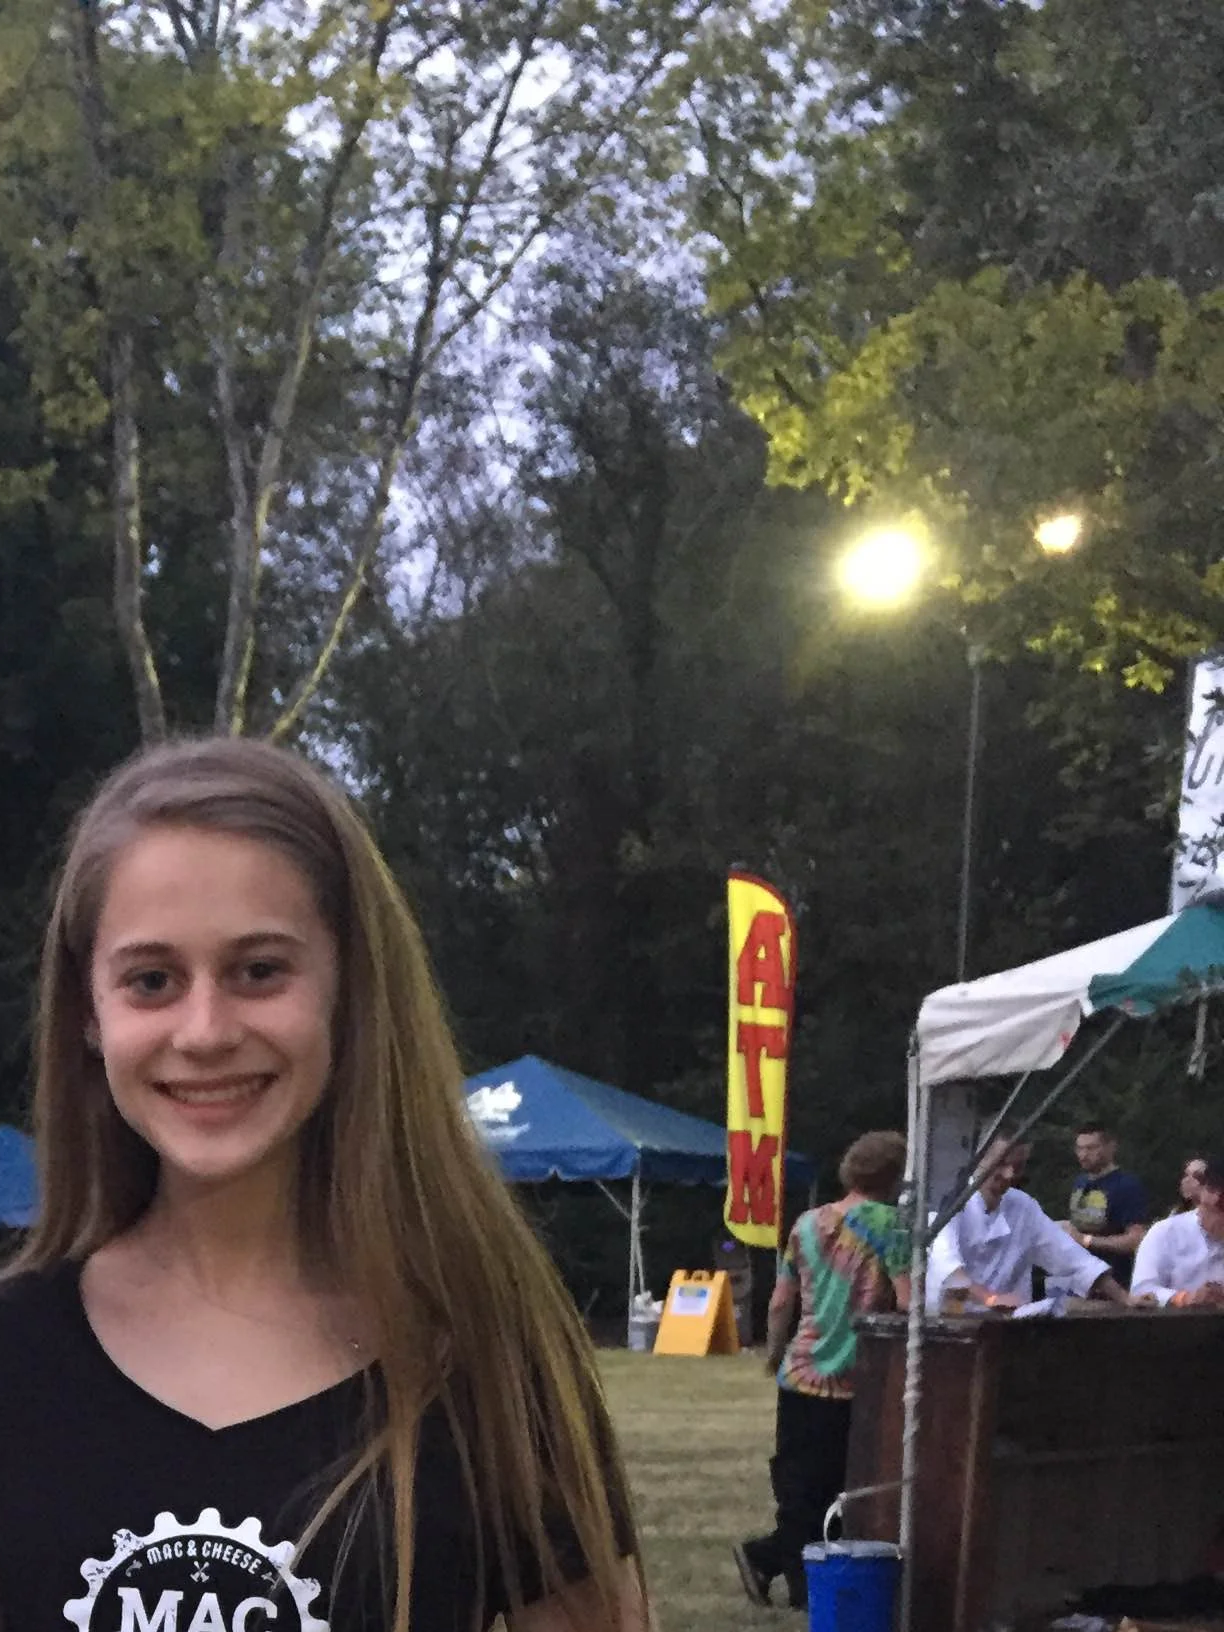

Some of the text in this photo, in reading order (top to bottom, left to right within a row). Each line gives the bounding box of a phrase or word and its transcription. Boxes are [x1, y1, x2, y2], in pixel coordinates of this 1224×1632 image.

[728, 911, 790, 1225] ATM
[147, 1540, 262, 1574] MAC & CHEESE
